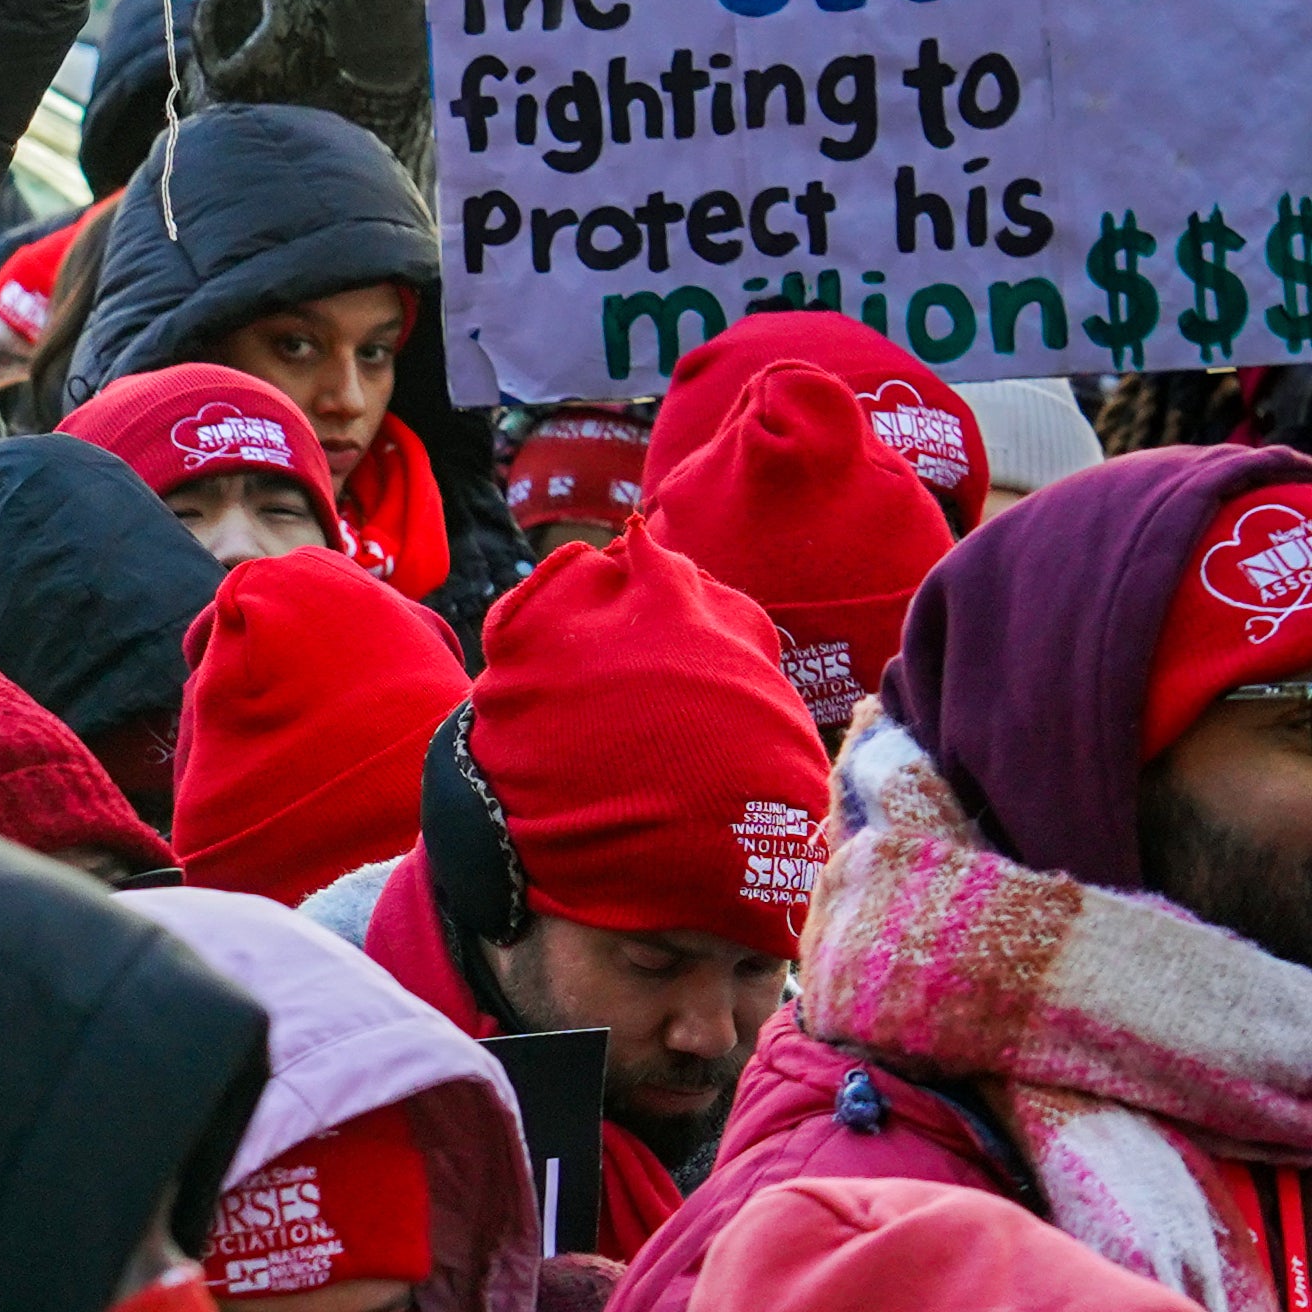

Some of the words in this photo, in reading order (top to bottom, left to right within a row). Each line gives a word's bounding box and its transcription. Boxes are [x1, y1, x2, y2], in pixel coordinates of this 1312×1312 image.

[450, 46, 878, 174] fighting
[903, 37, 1020, 150] to
[893, 156, 1054, 260] his
[870, 410, 964, 449] NURSES
[729, 823, 786, 837] NATIONAL
